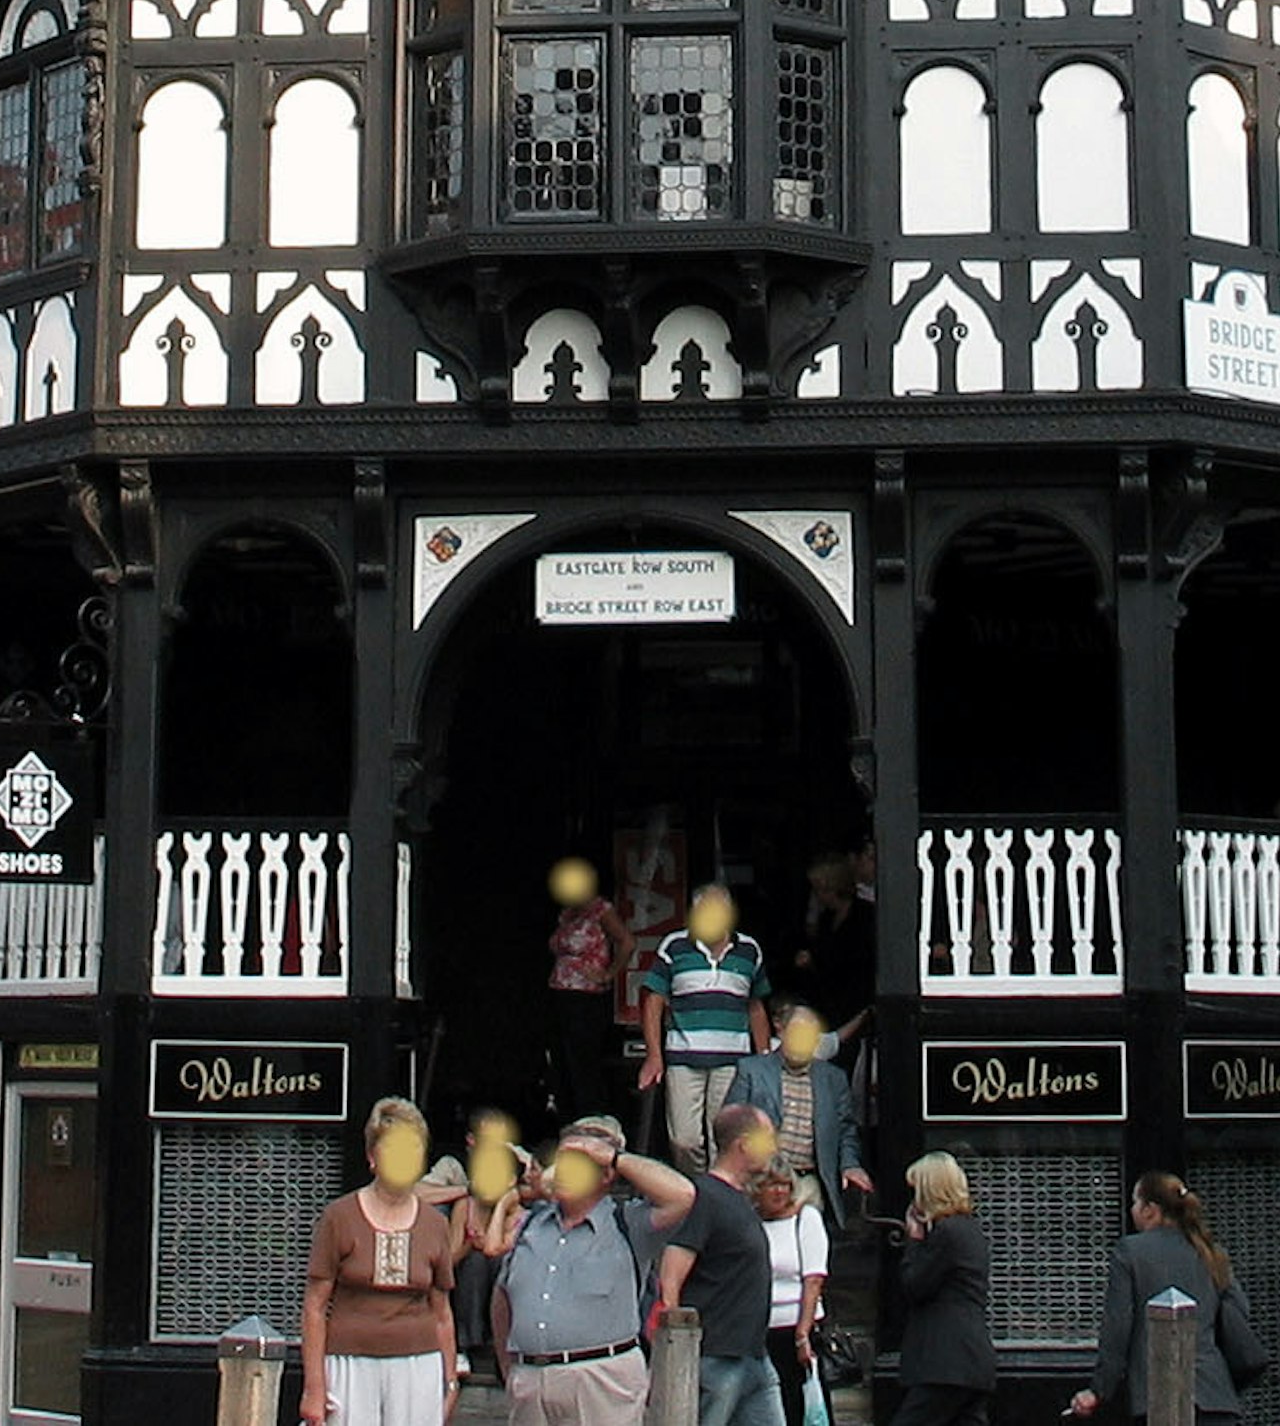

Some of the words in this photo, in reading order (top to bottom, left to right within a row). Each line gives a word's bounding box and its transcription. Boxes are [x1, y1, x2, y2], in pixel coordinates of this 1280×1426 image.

[1208, 317, 1276, 353] BRIDGE
[1207, 354, 1278, 388] STREET
[556, 561, 625, 575] EASTGATE
[632, 559, 662, 575] ROW
[669, 560, 715, 574] SOUTH
[545, 600, 593, 614] BRIDGE
[598, 600, 648, 614] STREET
[654, 599, 684, 613] ROW
[688, 598, 724, 612] EAST
[12, 774, 50, 793] MO
[11, 807, 50, 825] MO
[180, 1056, 322, 1102] Waltons
[952, 1057, 1099, 1104] Waltons
